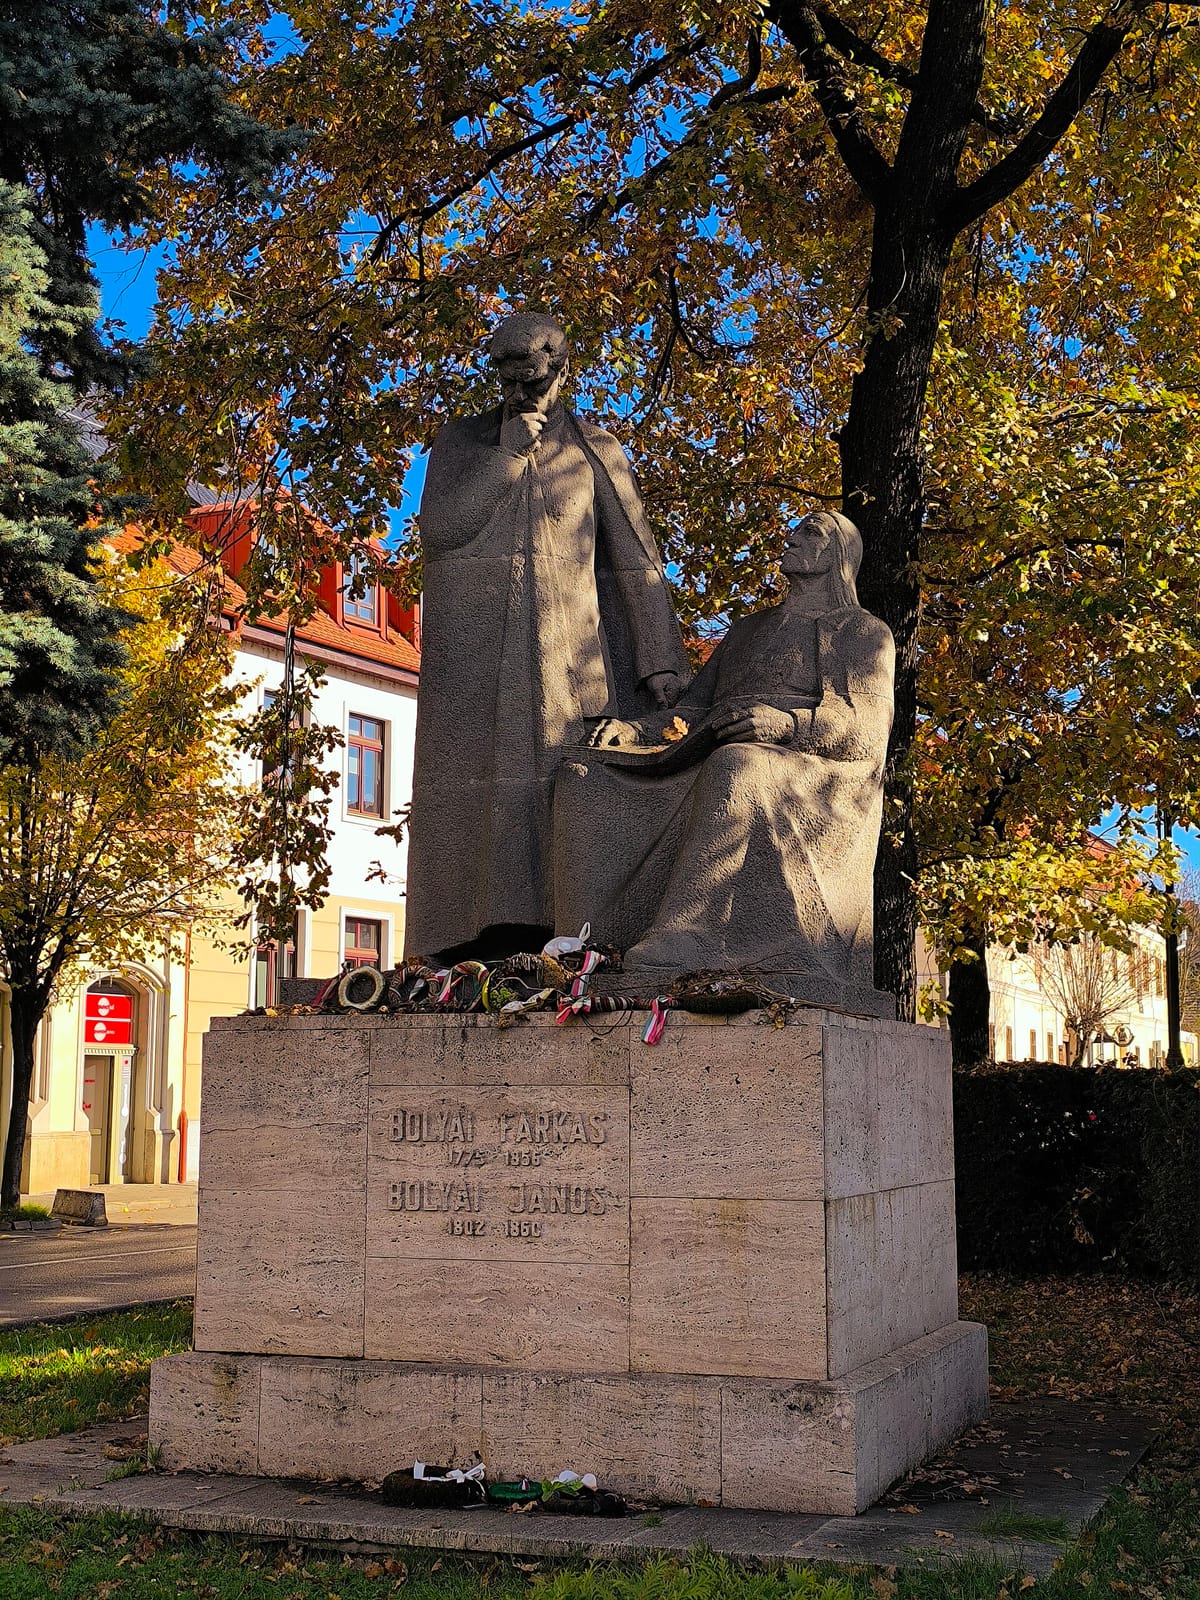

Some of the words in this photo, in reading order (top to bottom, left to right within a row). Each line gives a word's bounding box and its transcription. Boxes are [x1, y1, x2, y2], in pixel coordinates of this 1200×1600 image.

[388, 1110, 475, 1143] BOLYAI
[499, 1110, 607, 1145] FARKAS
[449, 1149, 486, 1167] 1775
[504, 1151, 542, 1168] 1856
[387, 1181, 481, 1212] BOLYAI
[449, 1218, 486, 1237] 1802
[504, 1220, 542, 1238] 1860
